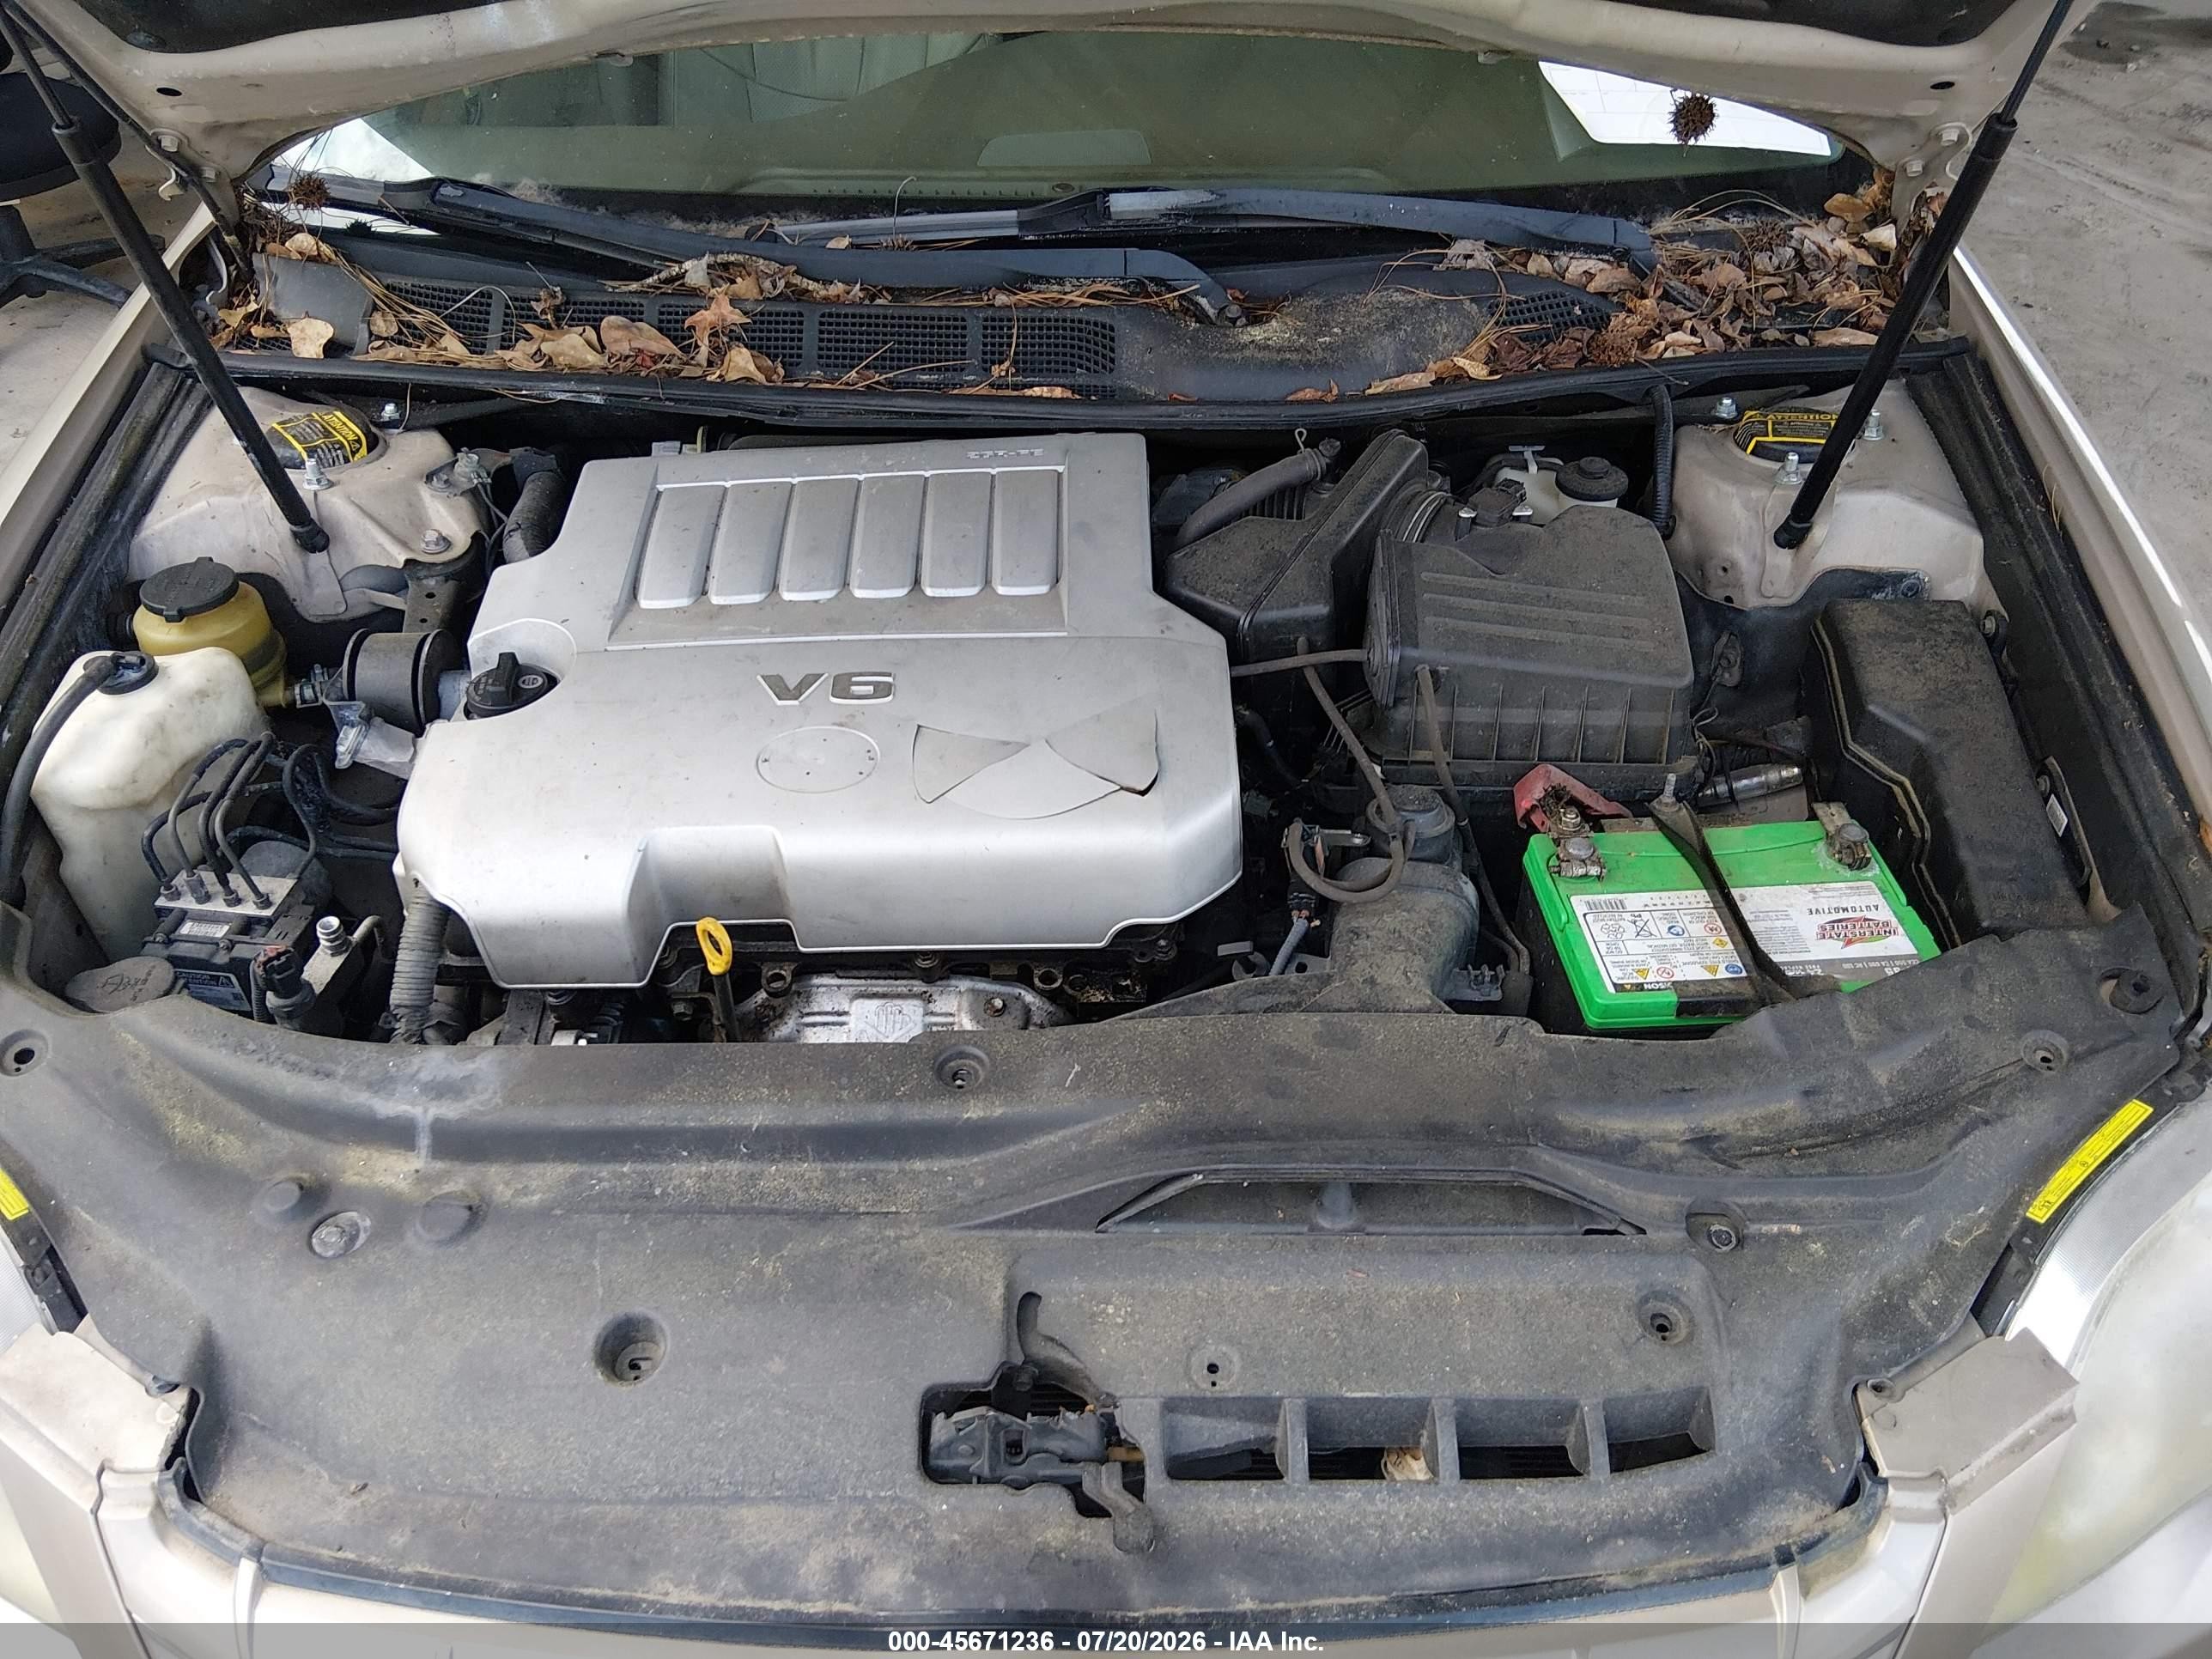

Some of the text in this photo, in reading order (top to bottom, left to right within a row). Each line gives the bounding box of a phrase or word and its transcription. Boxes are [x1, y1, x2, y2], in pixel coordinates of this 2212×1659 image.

[756, 672, 894, 705] V6
[1806, 904, 1879, 915] AUTOMOTIVE
[1817, 920, 1892, 932] BATTERIES
[1816, 927, 1899, 940] INTERSTATE
